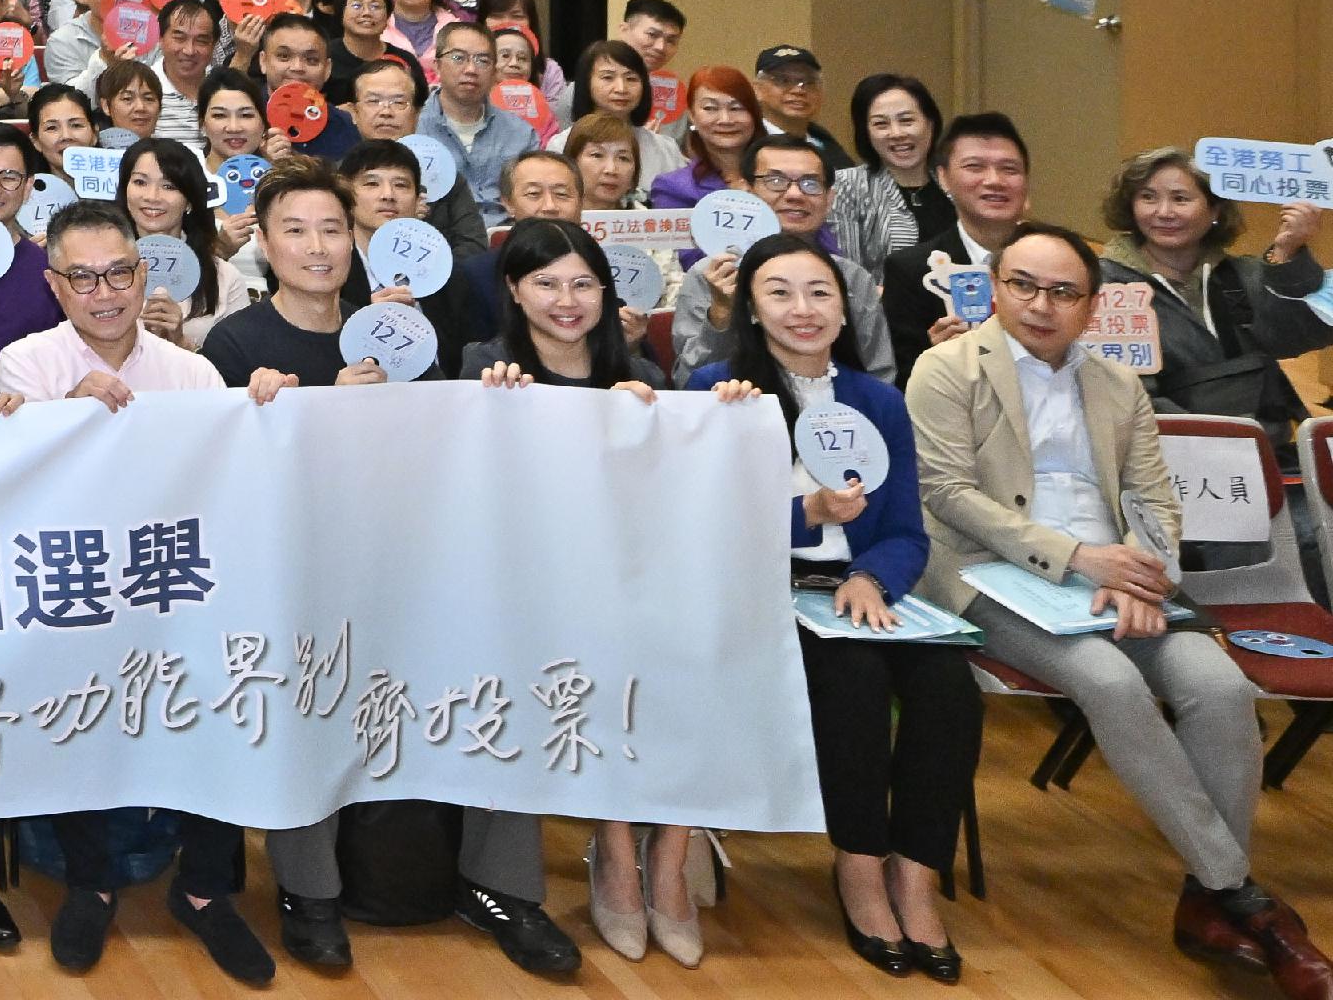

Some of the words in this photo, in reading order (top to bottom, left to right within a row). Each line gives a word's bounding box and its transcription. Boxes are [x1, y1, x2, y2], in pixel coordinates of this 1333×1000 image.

[1205, 145, 1313, 174] 全港勞工
[1221, 172, 1331, 200] 同心投票
